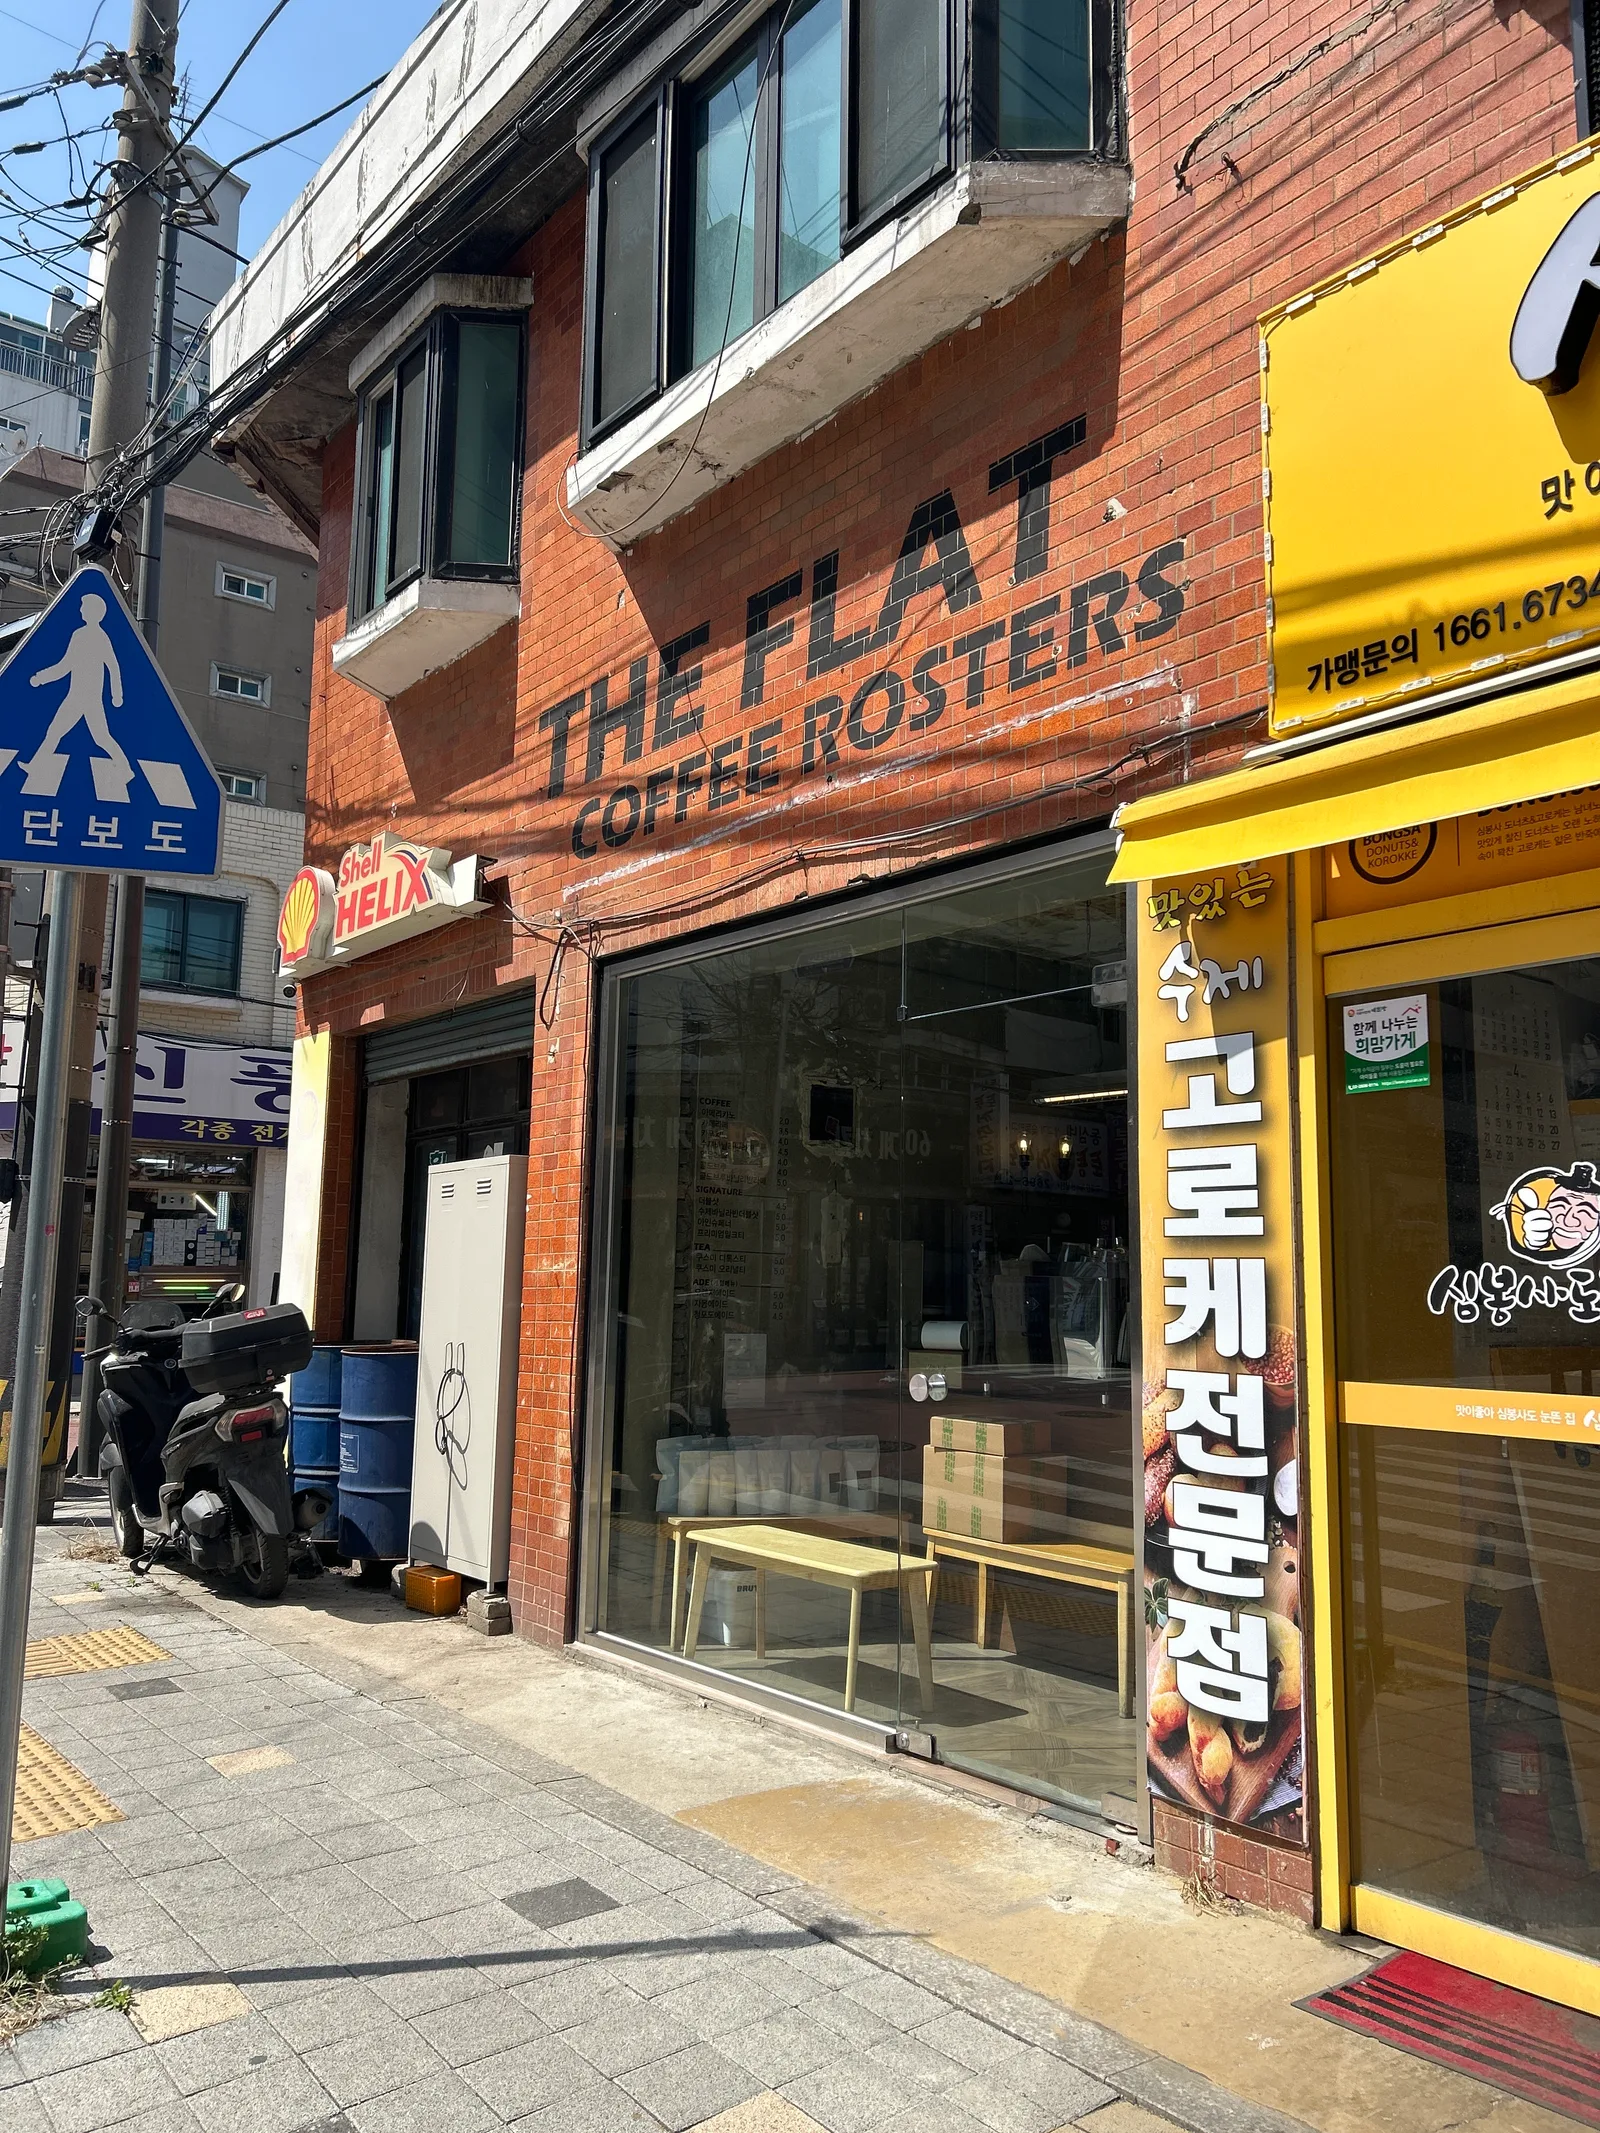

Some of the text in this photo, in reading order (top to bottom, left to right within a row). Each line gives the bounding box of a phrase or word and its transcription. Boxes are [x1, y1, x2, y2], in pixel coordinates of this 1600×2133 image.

[539, 414, 1086, 800] THE FLAT
[1307, 628, 1418, 693] 가맹문의
[570, 539, 1187, 860] COFFEE ROSTERS
[1366, 838, 1419, 858] DONUTS&
[1368, 850, 1418, 868] KOROKKE
[340, 840, 383, 887] Shell
[336, 858, 428, 938] HELIX
[1147, 867, 1274, 933] 맛있는
[1156, 940, 1264, 1023] 수제
[1353, 1016, 1417, 1036] 함께 나누는
[1356, 1031, 1416, 1054] 희망가게
[699, 1097, 732, 1108] COFFEE
[179, 1120, 236, 1140] 각종
[695, 1185, 743, 1196] SIGNATURE
[694, 1242, 711, 1251] TEA
[1455, 1404, 1494, 1420] 맛이좋아
[1497, 1407, 1537, 1422] 심봉사도
[1540, 1410, 1561, 1424] 눈뜬
[1564, 1412, 1576, 1426] 집
